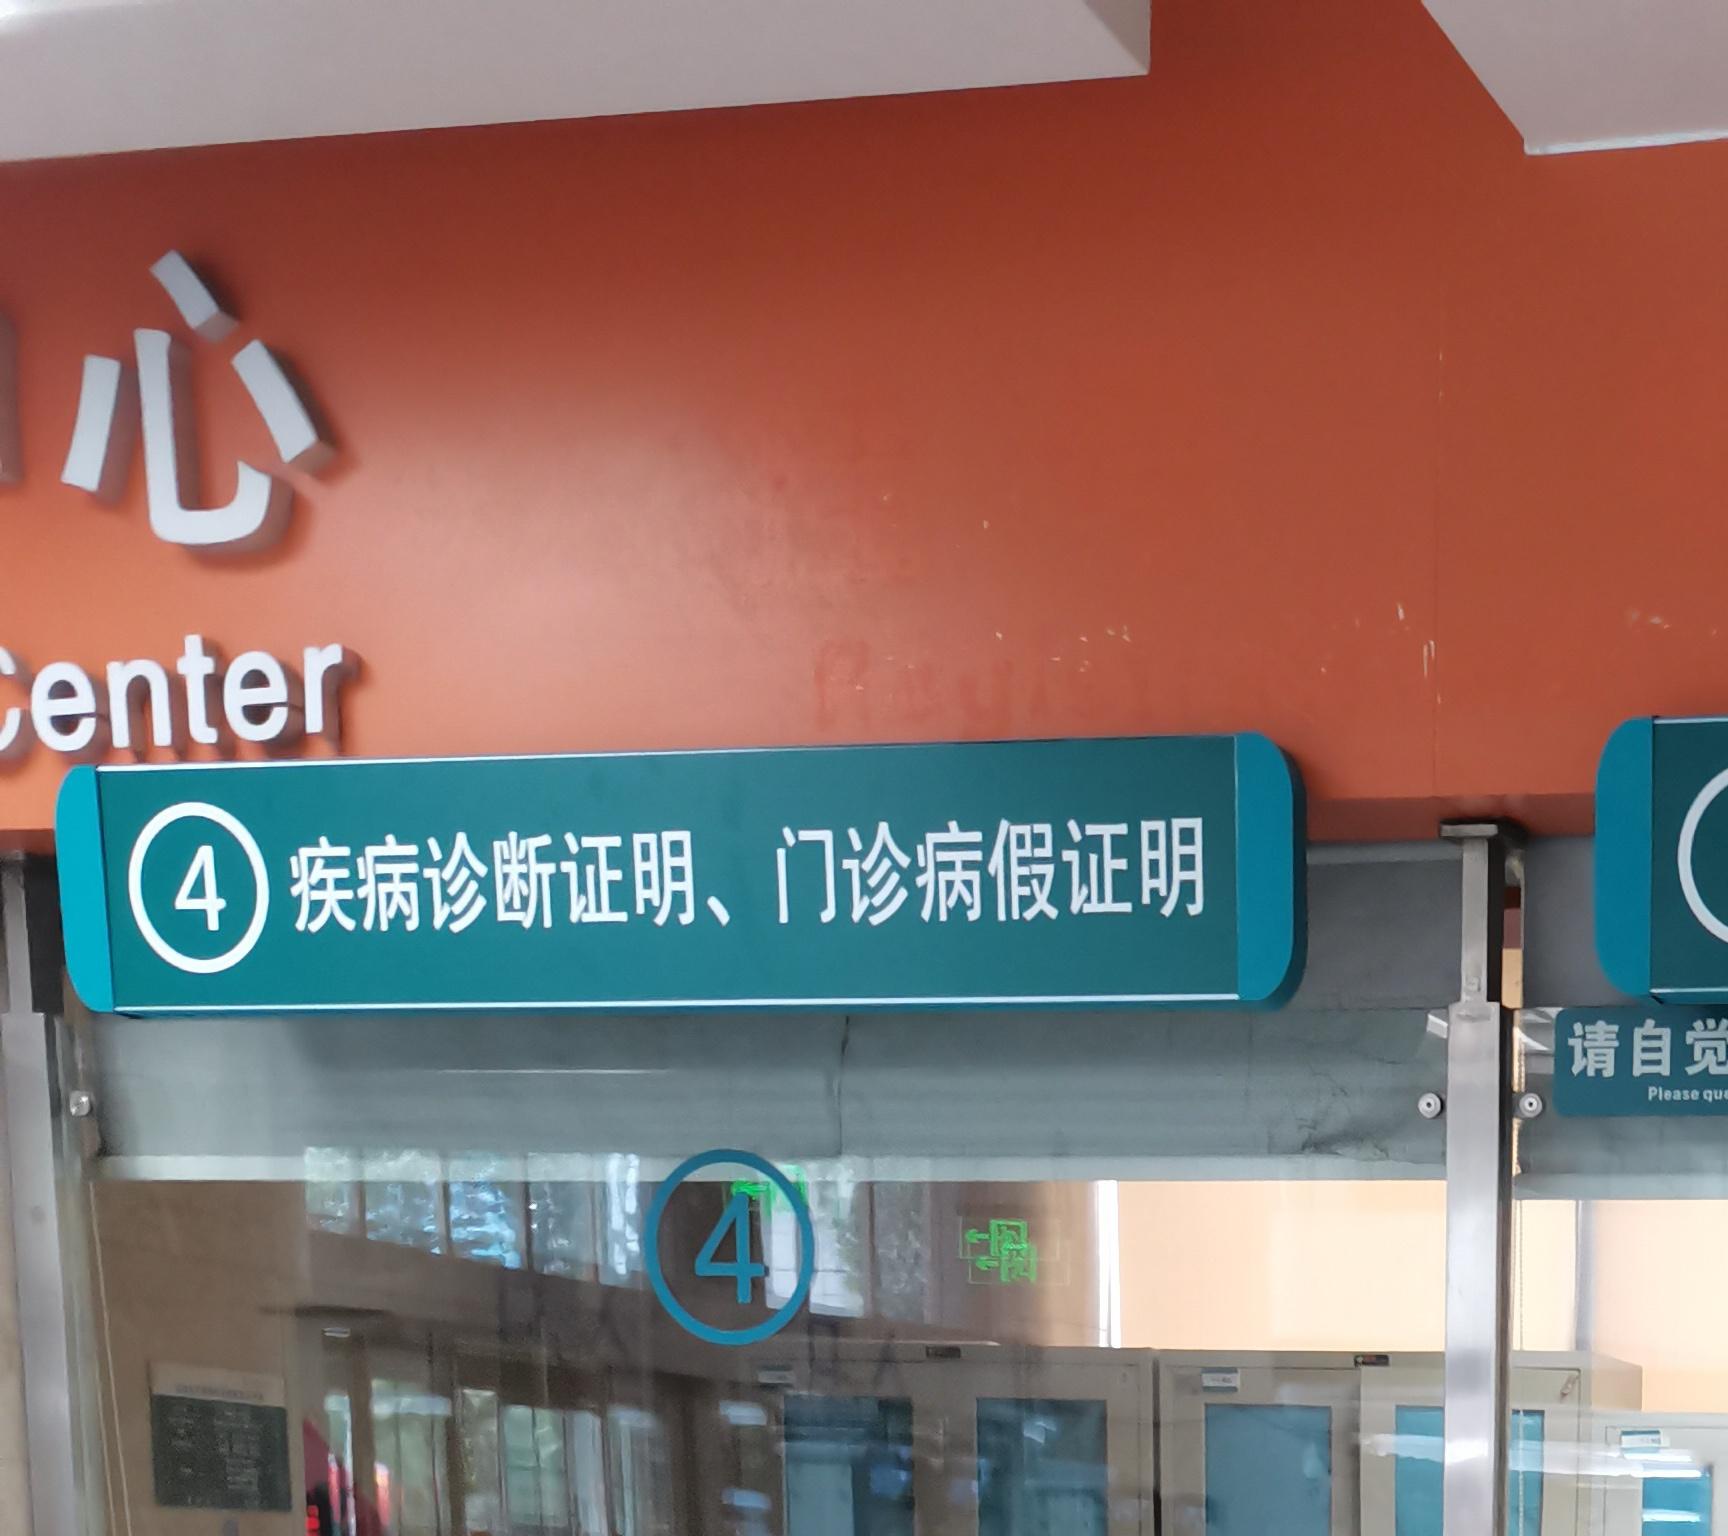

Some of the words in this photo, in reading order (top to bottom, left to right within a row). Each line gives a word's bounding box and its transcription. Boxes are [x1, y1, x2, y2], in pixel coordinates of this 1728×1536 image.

[290, 815, 1206, 934] 疾病诊断证明、门诊病假证明
[1648, 1086, 1700, 1101] Please
